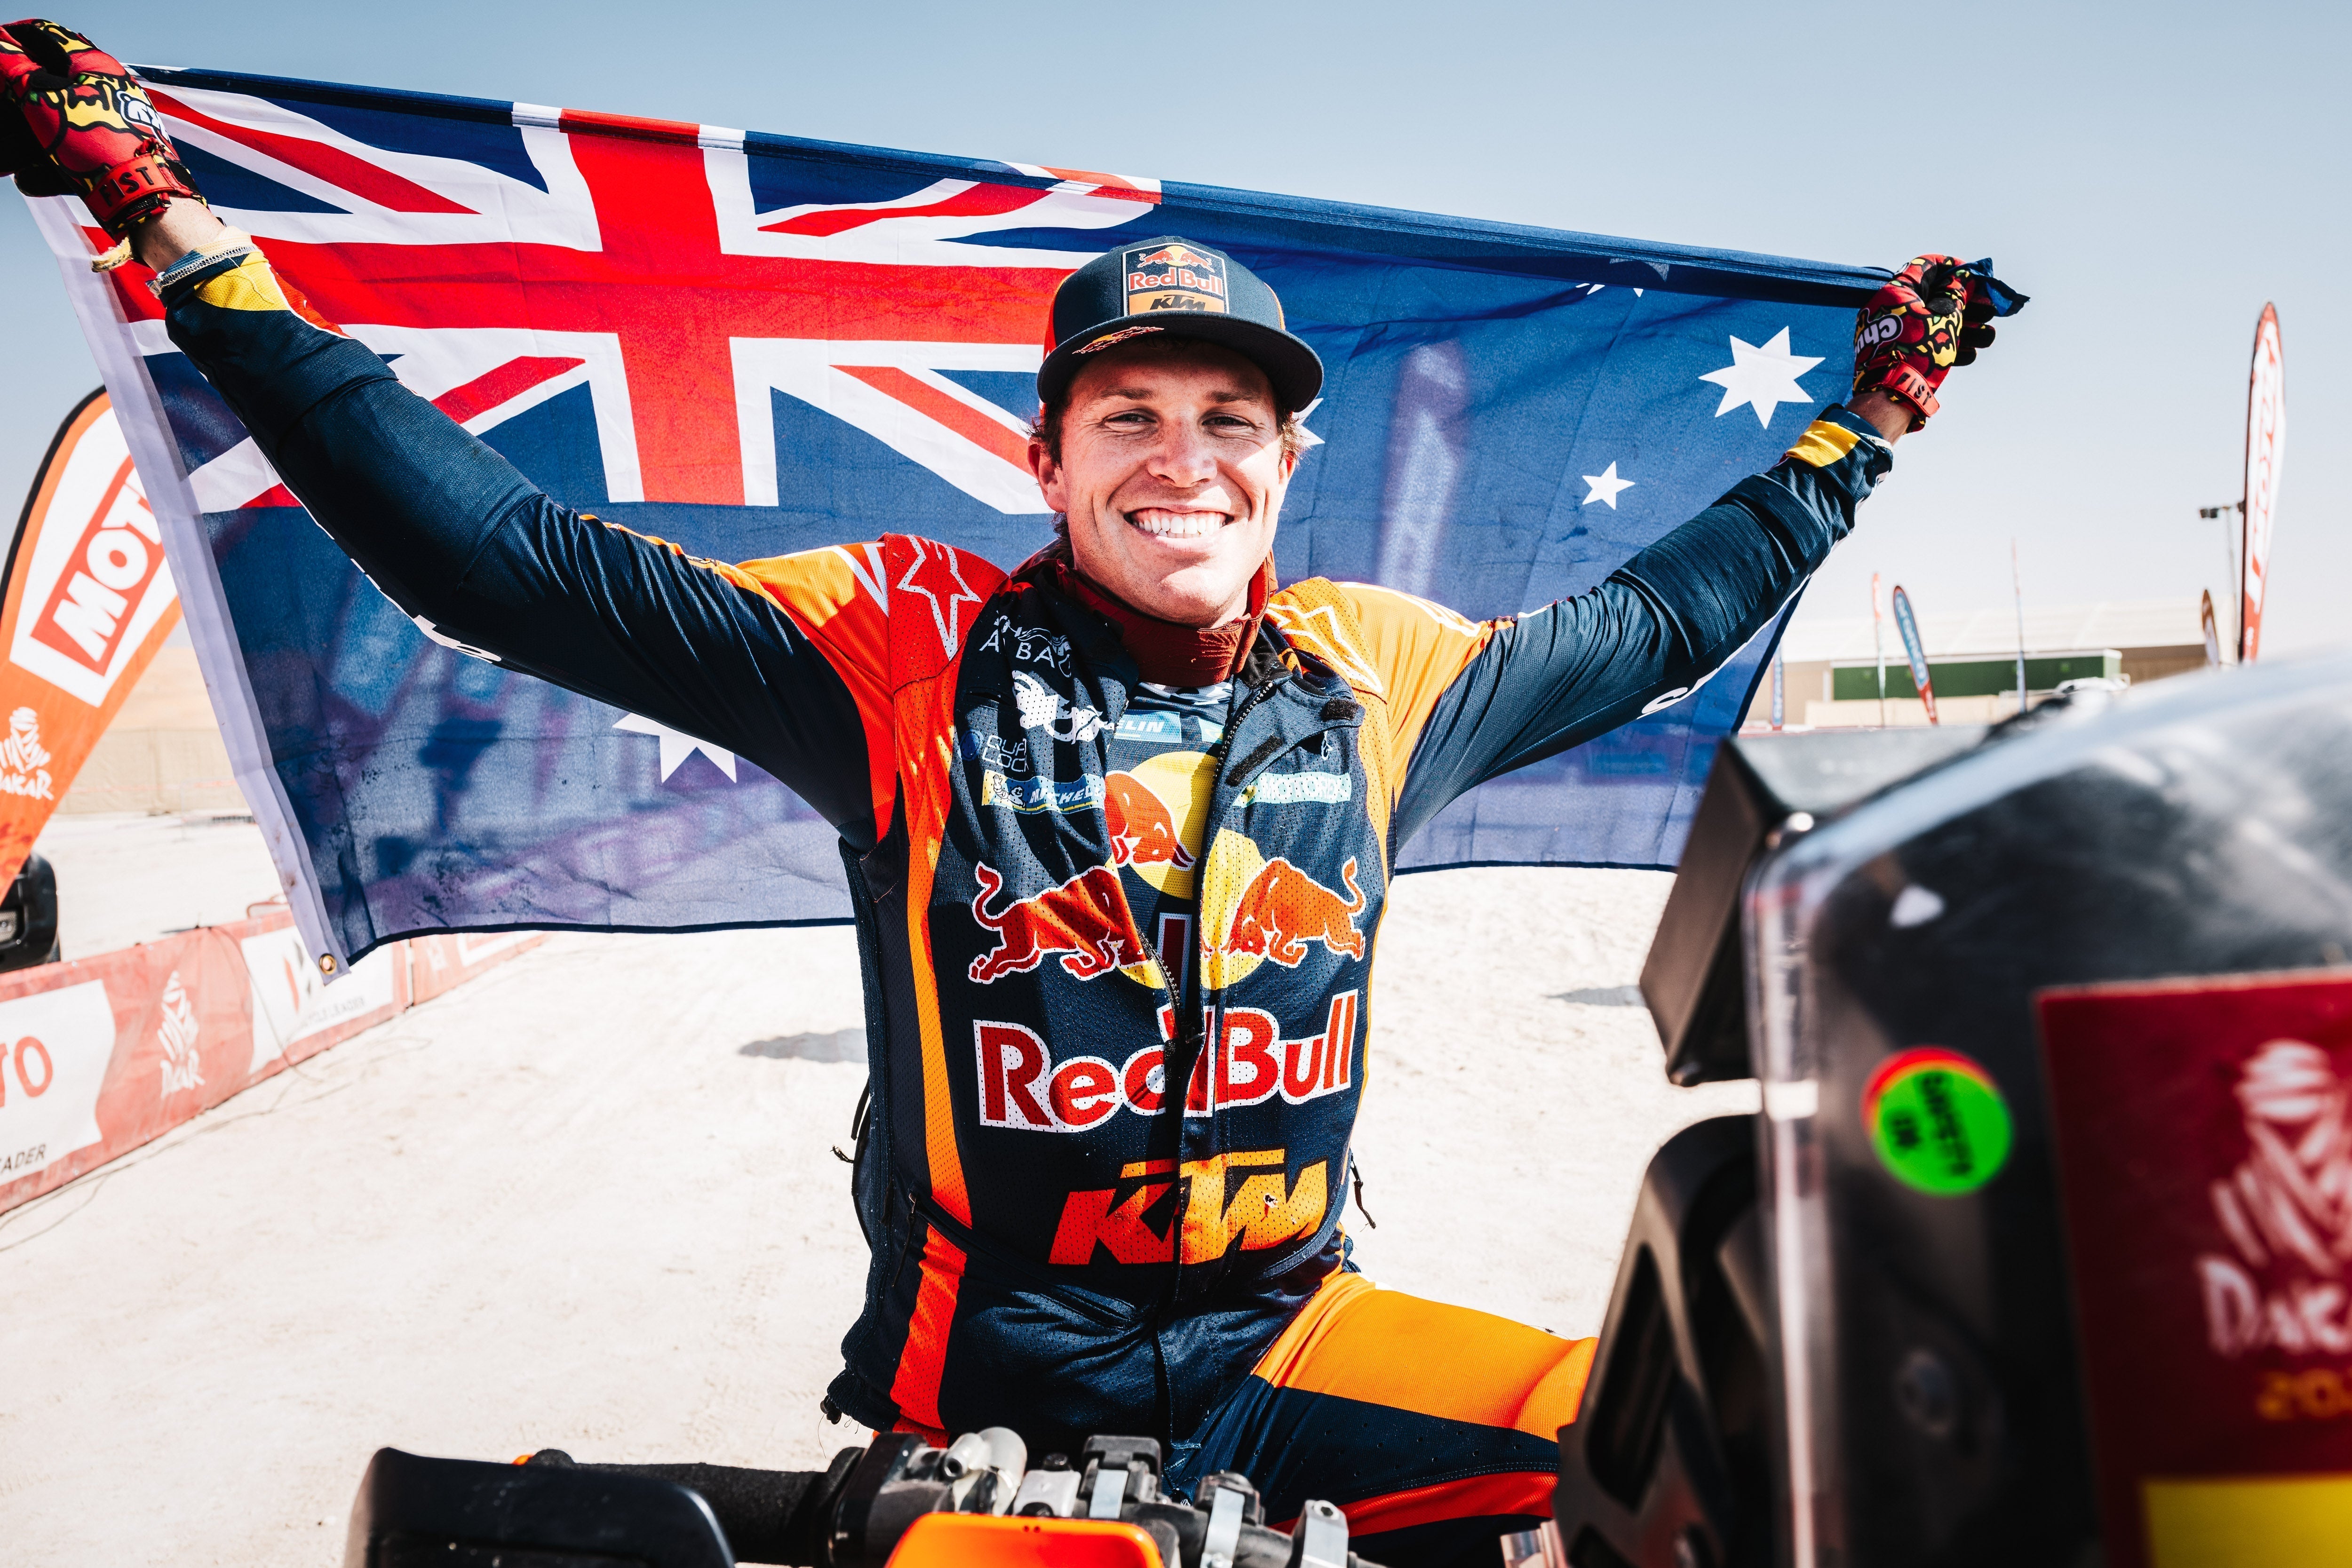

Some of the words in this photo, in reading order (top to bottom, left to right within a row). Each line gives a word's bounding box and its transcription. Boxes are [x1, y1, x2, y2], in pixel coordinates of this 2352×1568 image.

[99, 166, 154, 206] FIST
[1128, 267, 1176, 291] Red
[1179, 268, 1223, 296] Bull
[1150, 294, 1206, 311] KTM
[1897, 372, 1932, 406] FIST
[53, 466, 163, 662] MOT
[0, 766, 55, 801] AKAR
[1029, 785, 1105, 804] MICHELI
[973, 1006, 1215, 1133] Red
[1215, 989, 1358, 1110] Bull
[0, 1144, 46, 1173] ADER
[1048, 1148, 1327, 1265] KTM
[2202, 1257, 2352, 1355] DAK
[2257, 1369, 2352, 1420] 20
